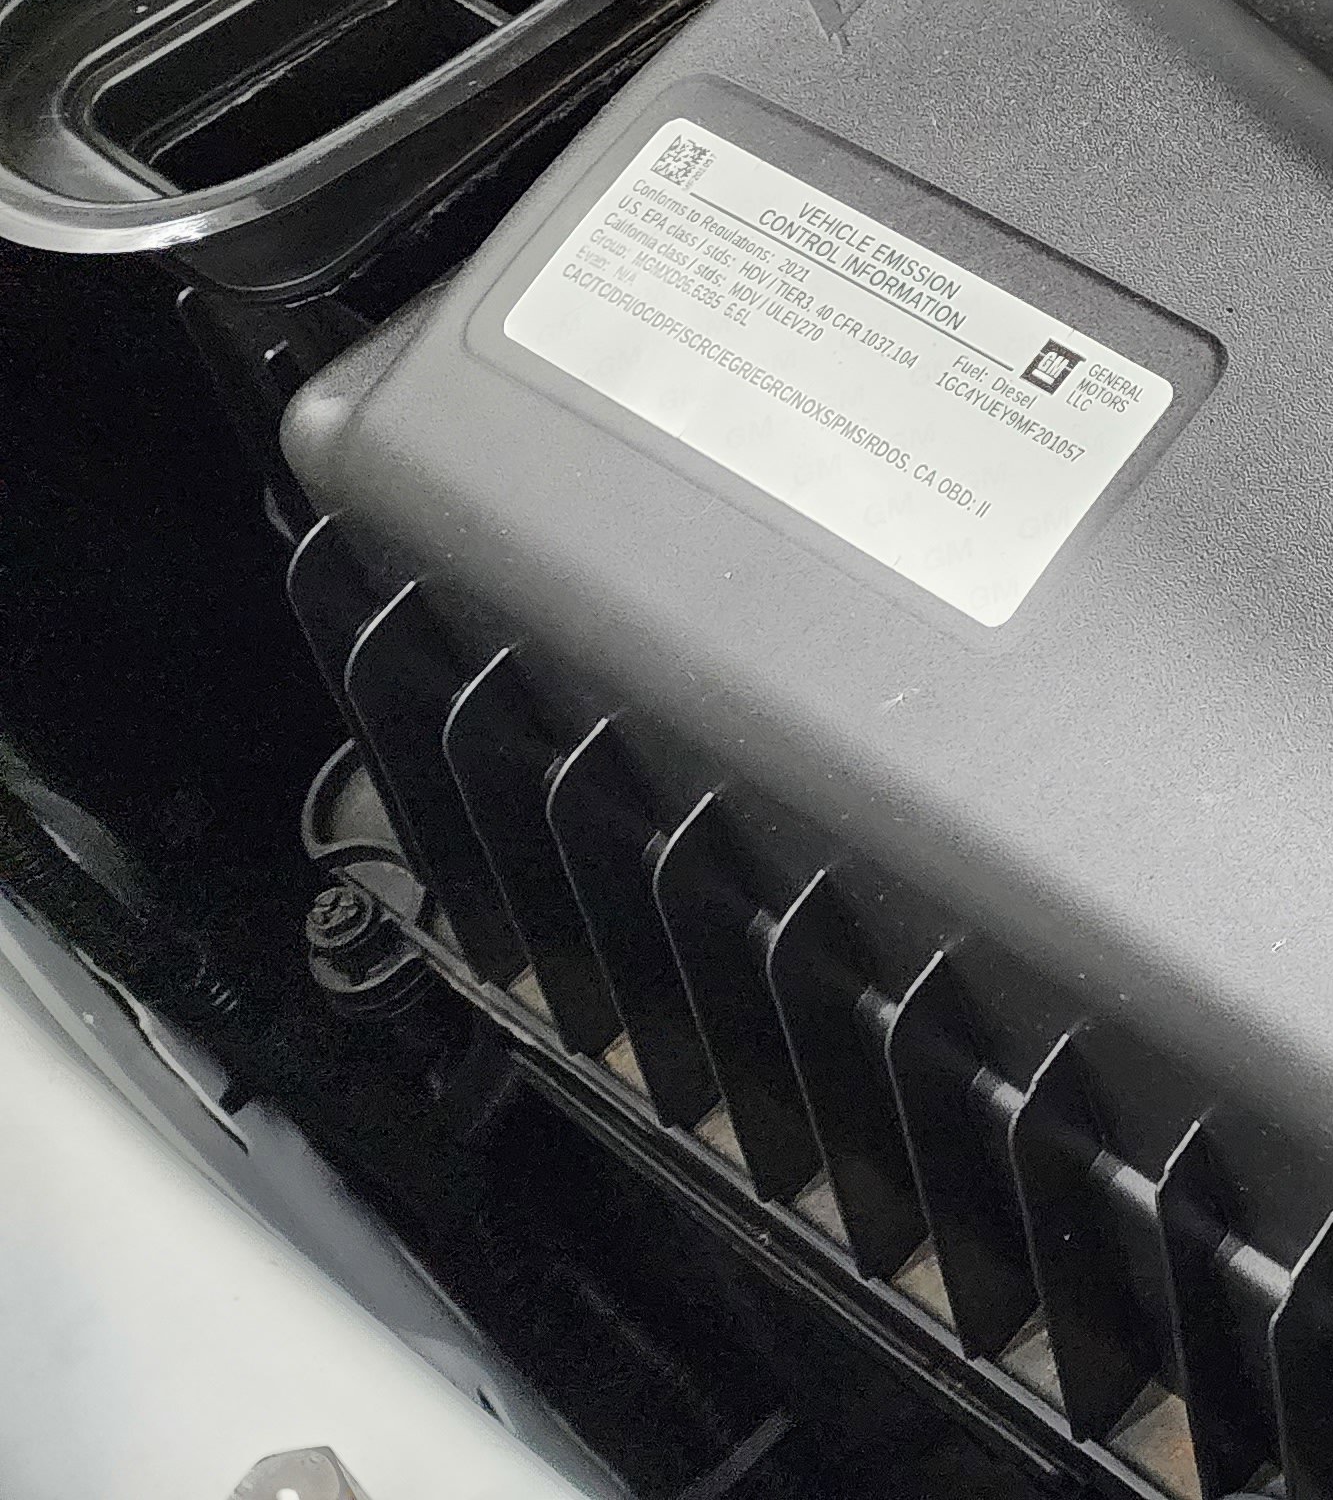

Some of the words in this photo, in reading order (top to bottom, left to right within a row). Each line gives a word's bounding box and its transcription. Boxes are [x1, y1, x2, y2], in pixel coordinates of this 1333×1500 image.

[632, 178, 688, 216] Conforms
[685, 208, 702, 223] to
[699, 215, 775, 264] Regulations:
[777, 257, 810, 283] 2021
[798, 202, 875, 253] VEHICLE
[871, 243, 961, 299] EMISSION
[603, 211, 658, 250] California
[656, 242, 690, 267] class
[693, 263, 727, 288] stds:
[727, 281, 763, 306] MDV
[765, 301, 824, 341] ULEV270
[617, 194, 643, 217] U.S.
[640, 207, 669, 231] EPA
[665, 224, 699, 247] class
[702, 244, 736, 268] stds:
[738, 260, 772, 285] HDV
[815, 303, 834, 321] 40
[831, 312, 863, 338] CFR
[859, 328, 919, 368] 1037.104
[758, 209, 839, 264] CONTROL
[841, 254, 966, 330] INFORMATION
[723, 302, 751, 327] 6.6L
[936, 372, 1084, 461] 1GC4YUEY9MF201057
[951, 354, 989, 383] Fuel:
[990, 376, 1038, 409] Diesel
[1065, 389, 1093, 412] LLC
[1076, 378, 1130, 413] MOTORS
[1088, 363, 1143, 402] GENERAL
[912, 463, 937, 487] CA
[937, 477, 976, 511] OBD:
